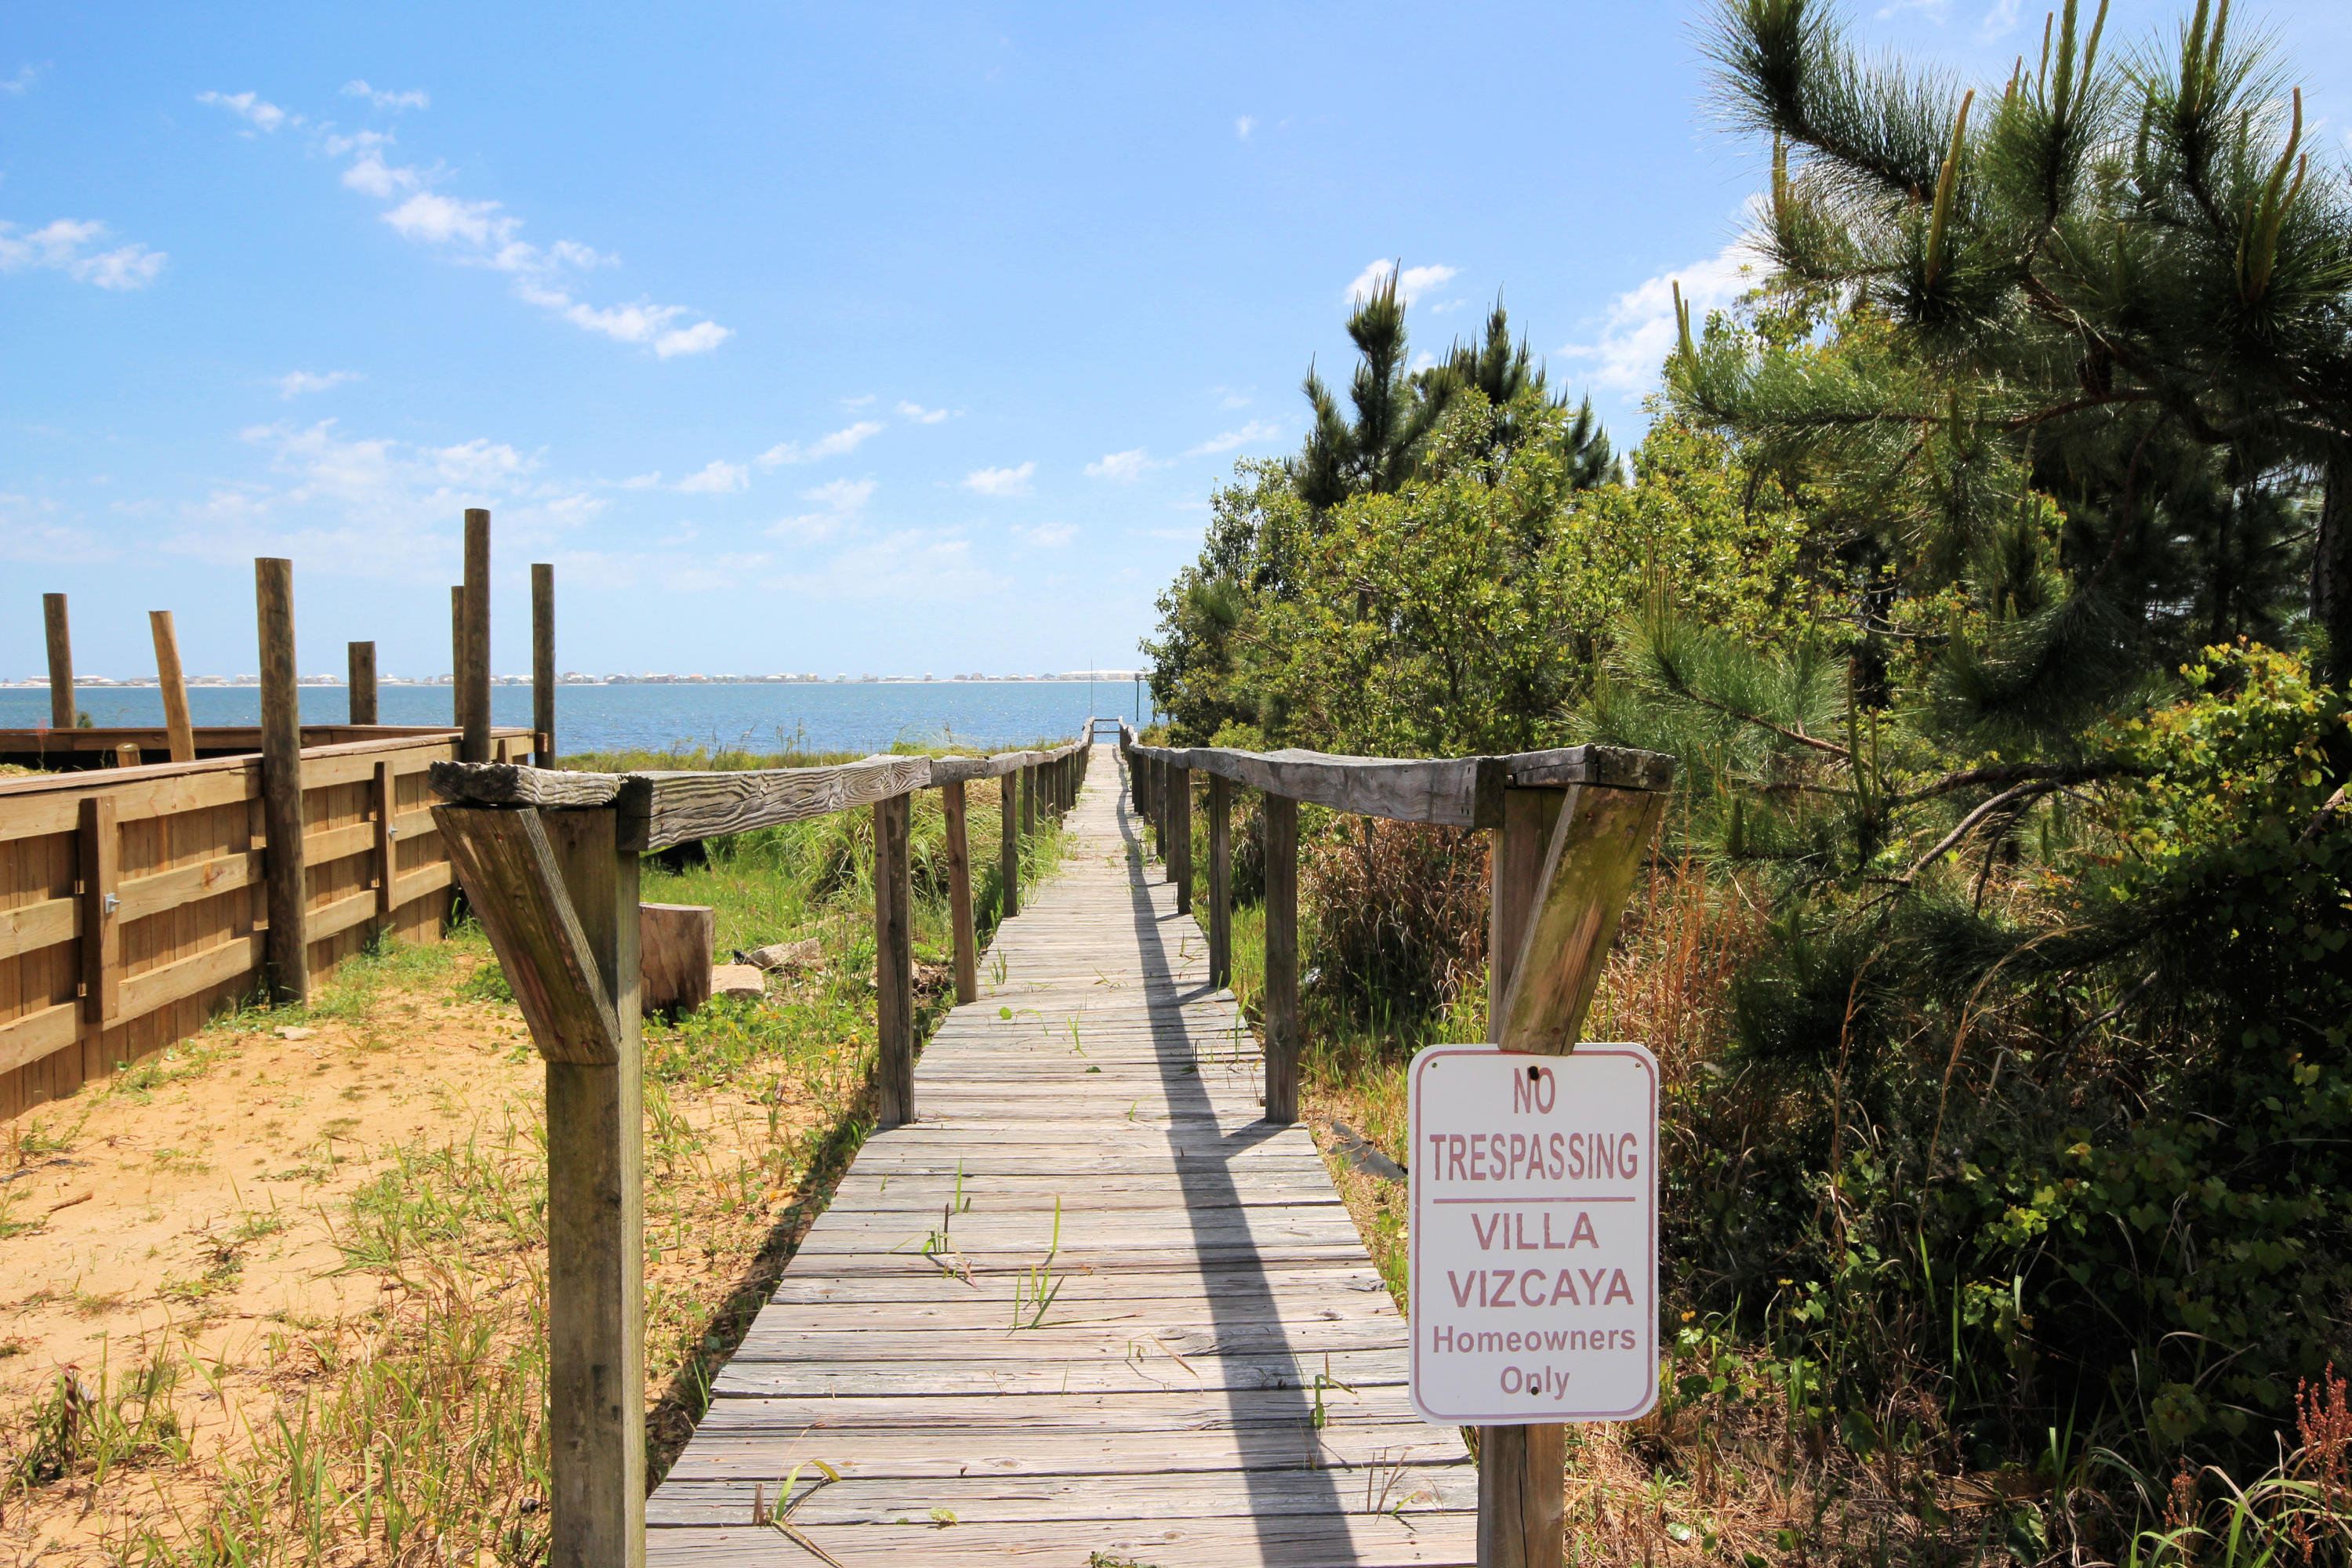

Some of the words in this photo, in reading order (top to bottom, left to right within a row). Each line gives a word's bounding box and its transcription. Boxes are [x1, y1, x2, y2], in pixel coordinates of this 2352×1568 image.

[1514, 1067, 1555, 1114] NO
[1429, 1132, 1638, 1181] TRESPASSING
[1471, 1211, 1599, 1250] VILLA
[1446, 1268, 1634, 1308] VIZCAYA
[1433, 1325, 1636, 1353] Homeowners
[1500, 1365, 1570, 1400] Only
